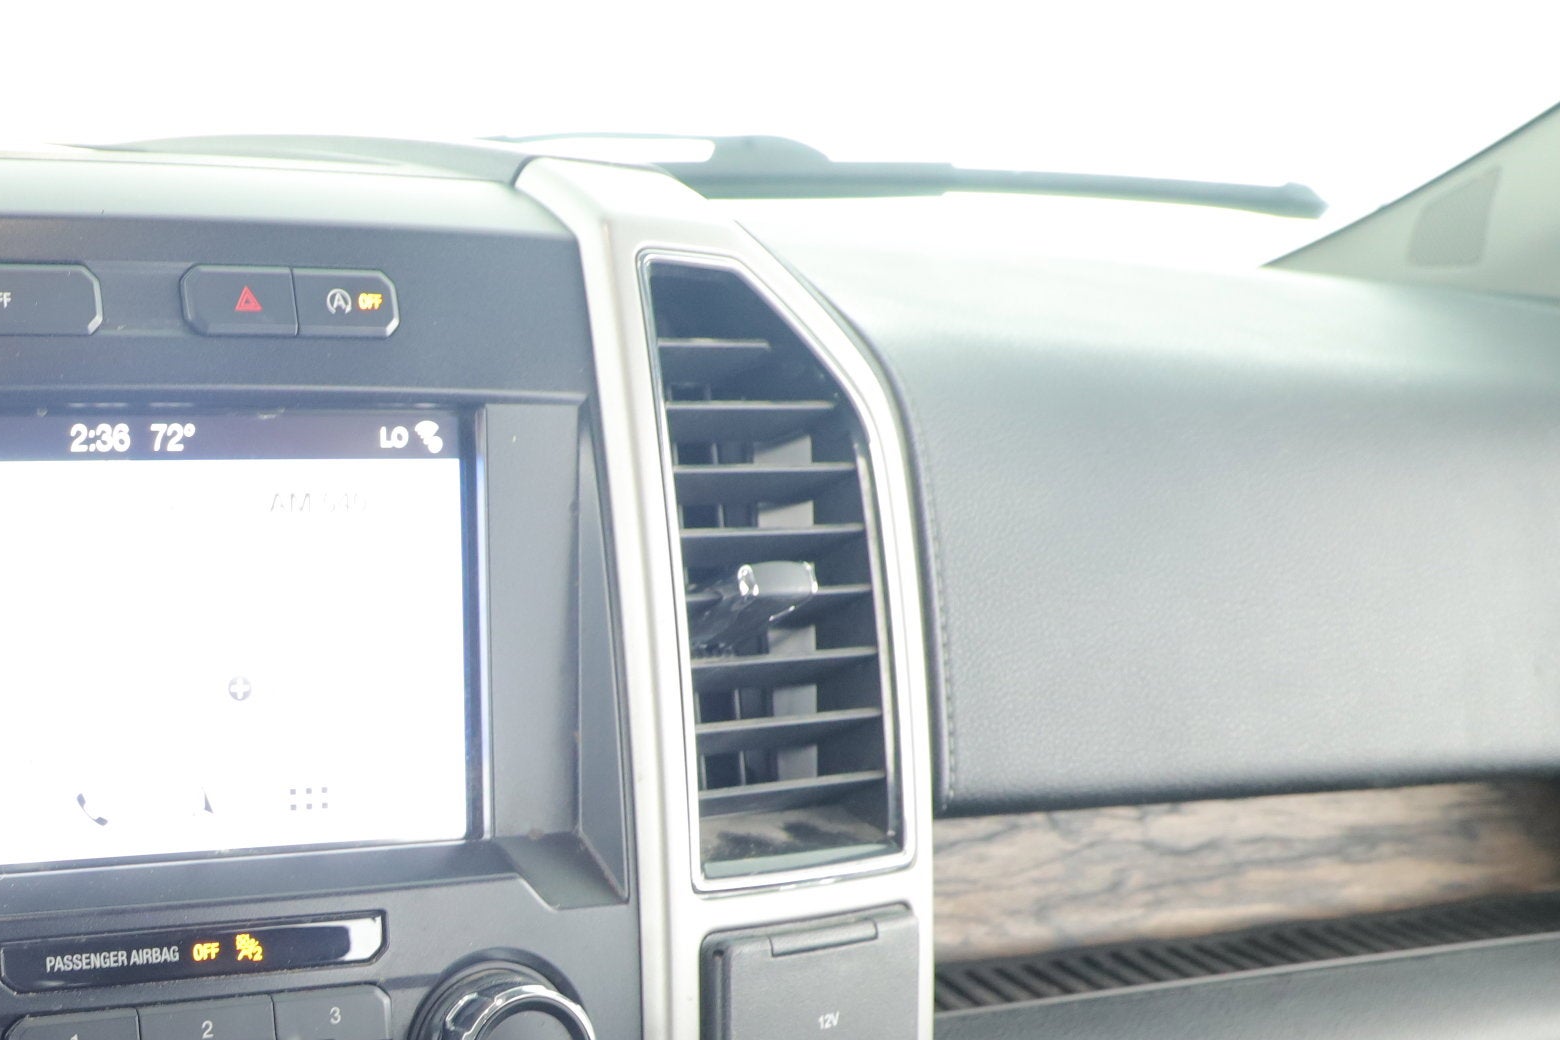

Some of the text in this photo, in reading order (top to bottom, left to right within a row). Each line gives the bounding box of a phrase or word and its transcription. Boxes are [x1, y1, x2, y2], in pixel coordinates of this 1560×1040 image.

[358, 293, 382, 310] OFF
[71, 423, 195, 452] 2:36 72°
[380, 426, 409, 448] LO
[46, 942, 219, 972] PASSENGER AIRBAG OFF
[330, 1007, 341, 1023] 3
[819, 1012, 839, 1029] 12V
[202, 1021, 213, 1038] 2
